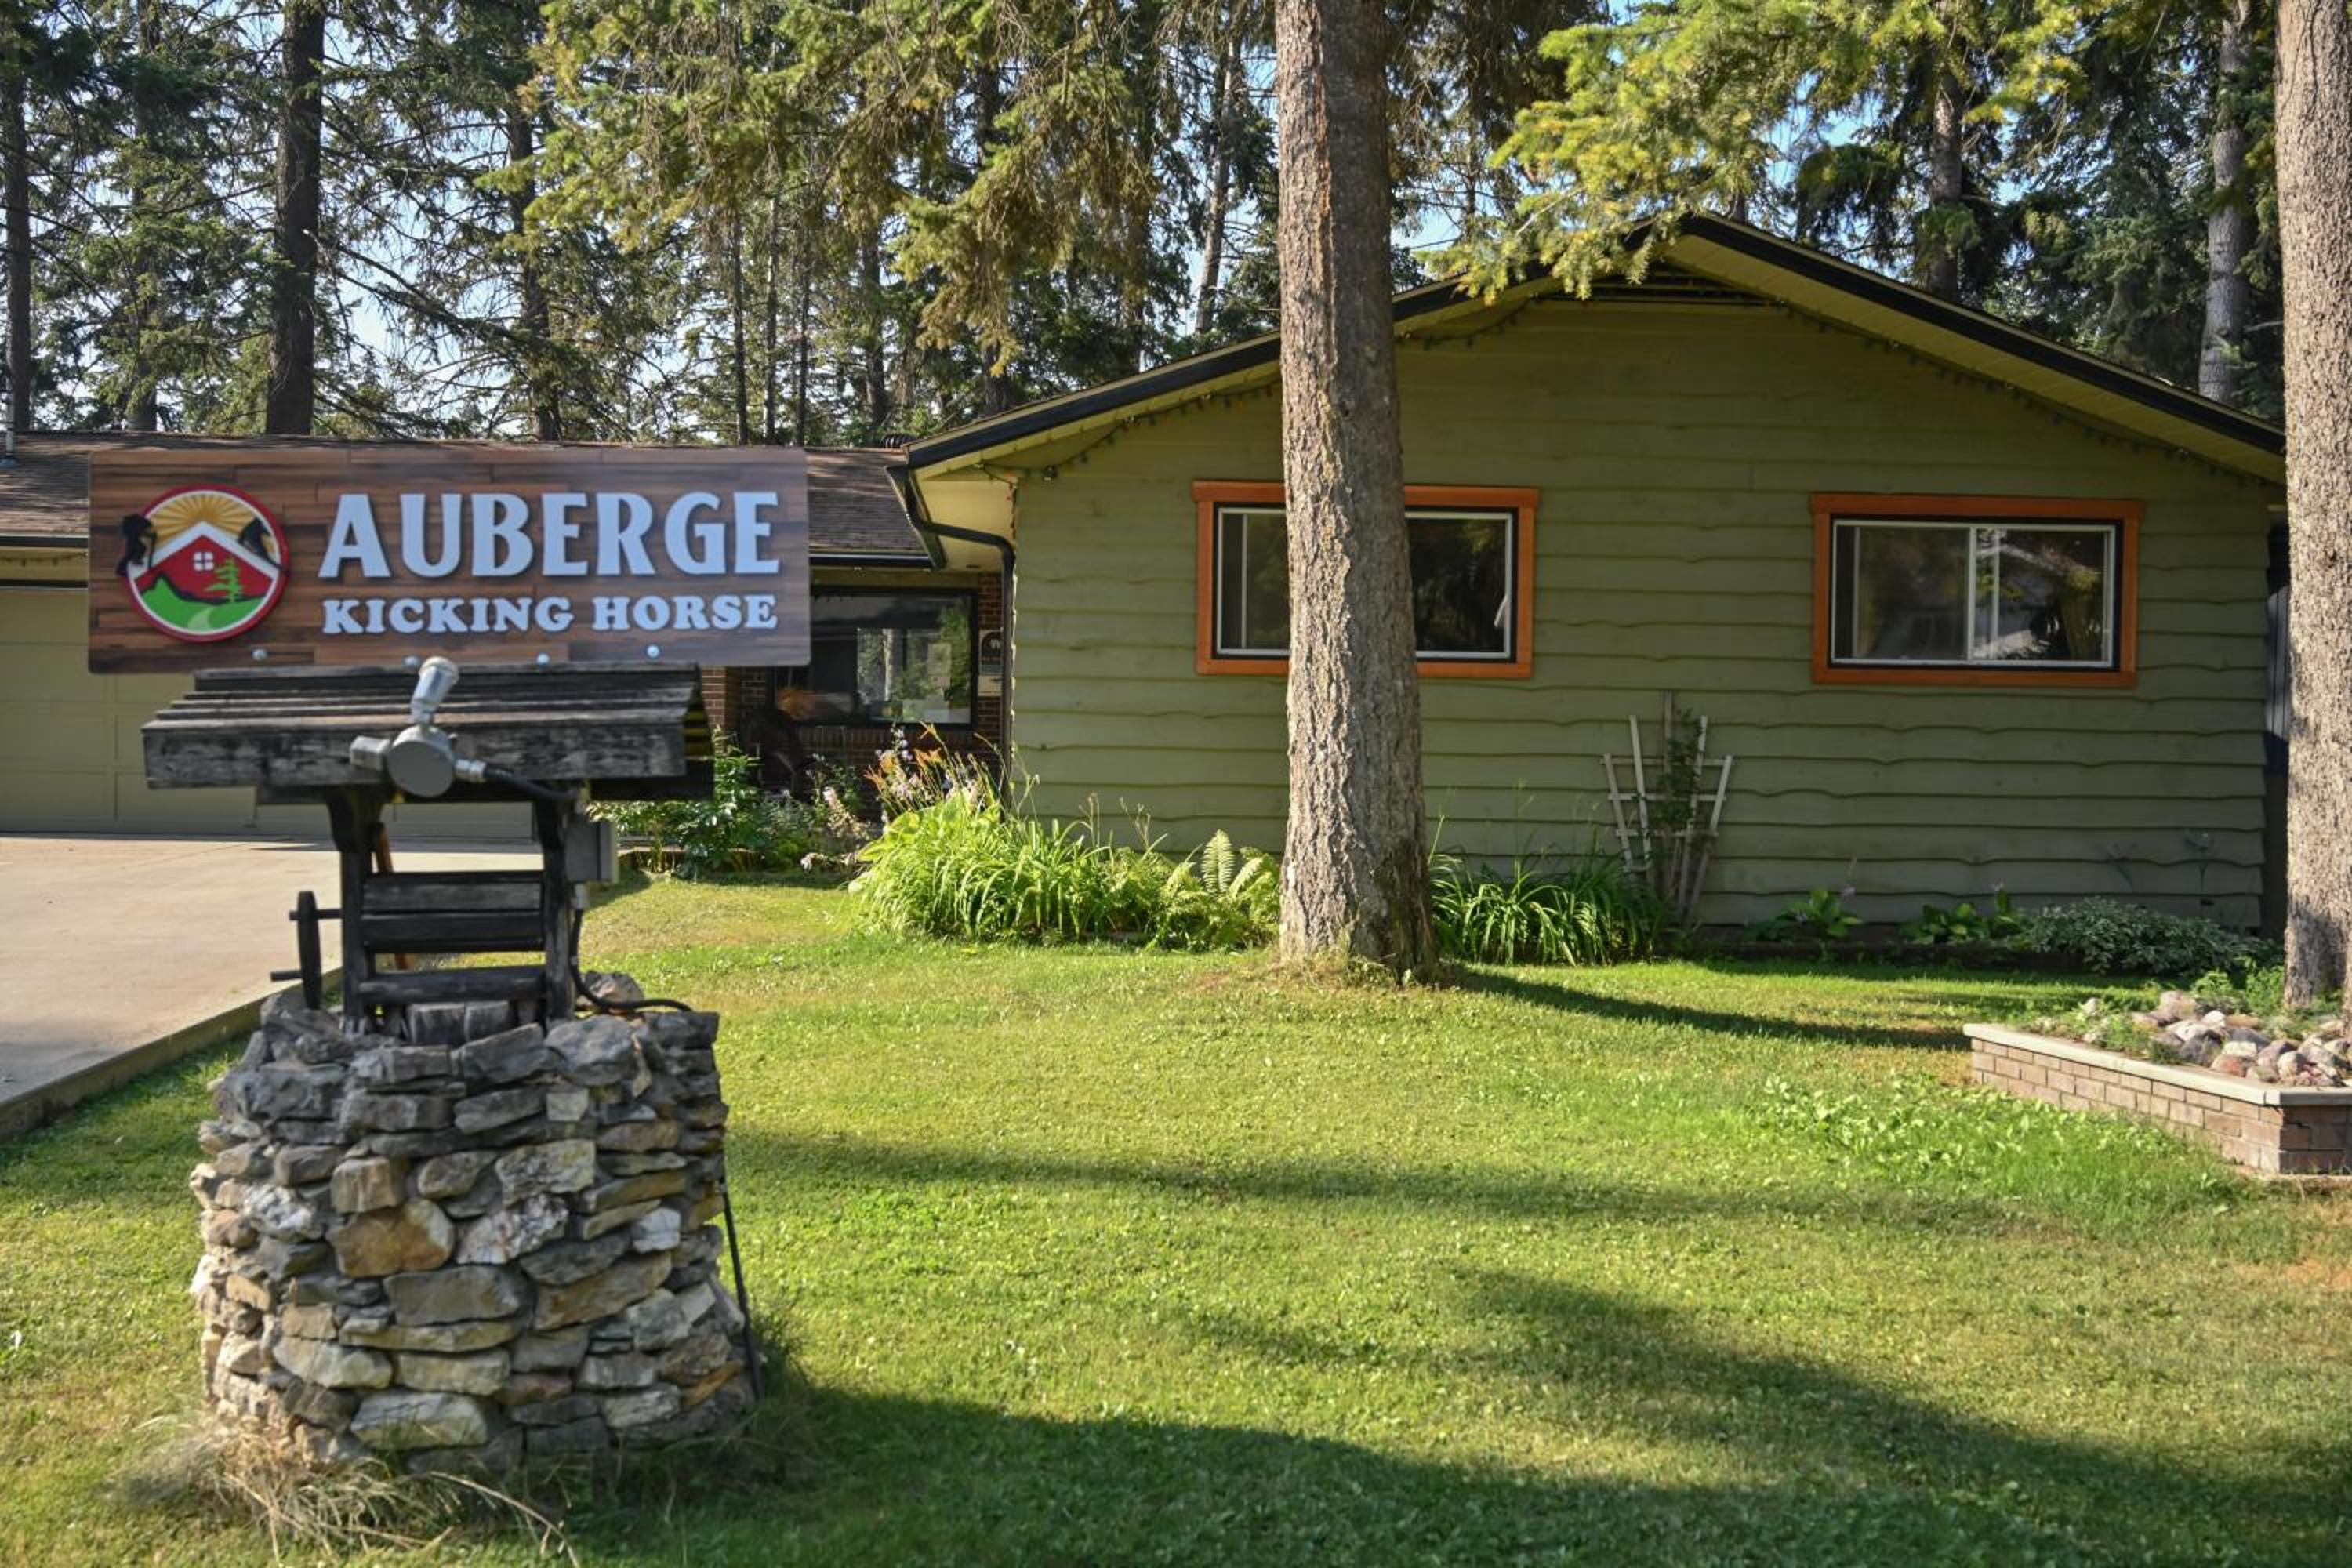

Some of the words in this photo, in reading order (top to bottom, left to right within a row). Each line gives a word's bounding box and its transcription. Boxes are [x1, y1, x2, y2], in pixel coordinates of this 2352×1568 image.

[318, 492, 779, 578] AUBERGE
[322, 597, 575, 633] KICKING
[593, 595, 779, 631] HORSE
